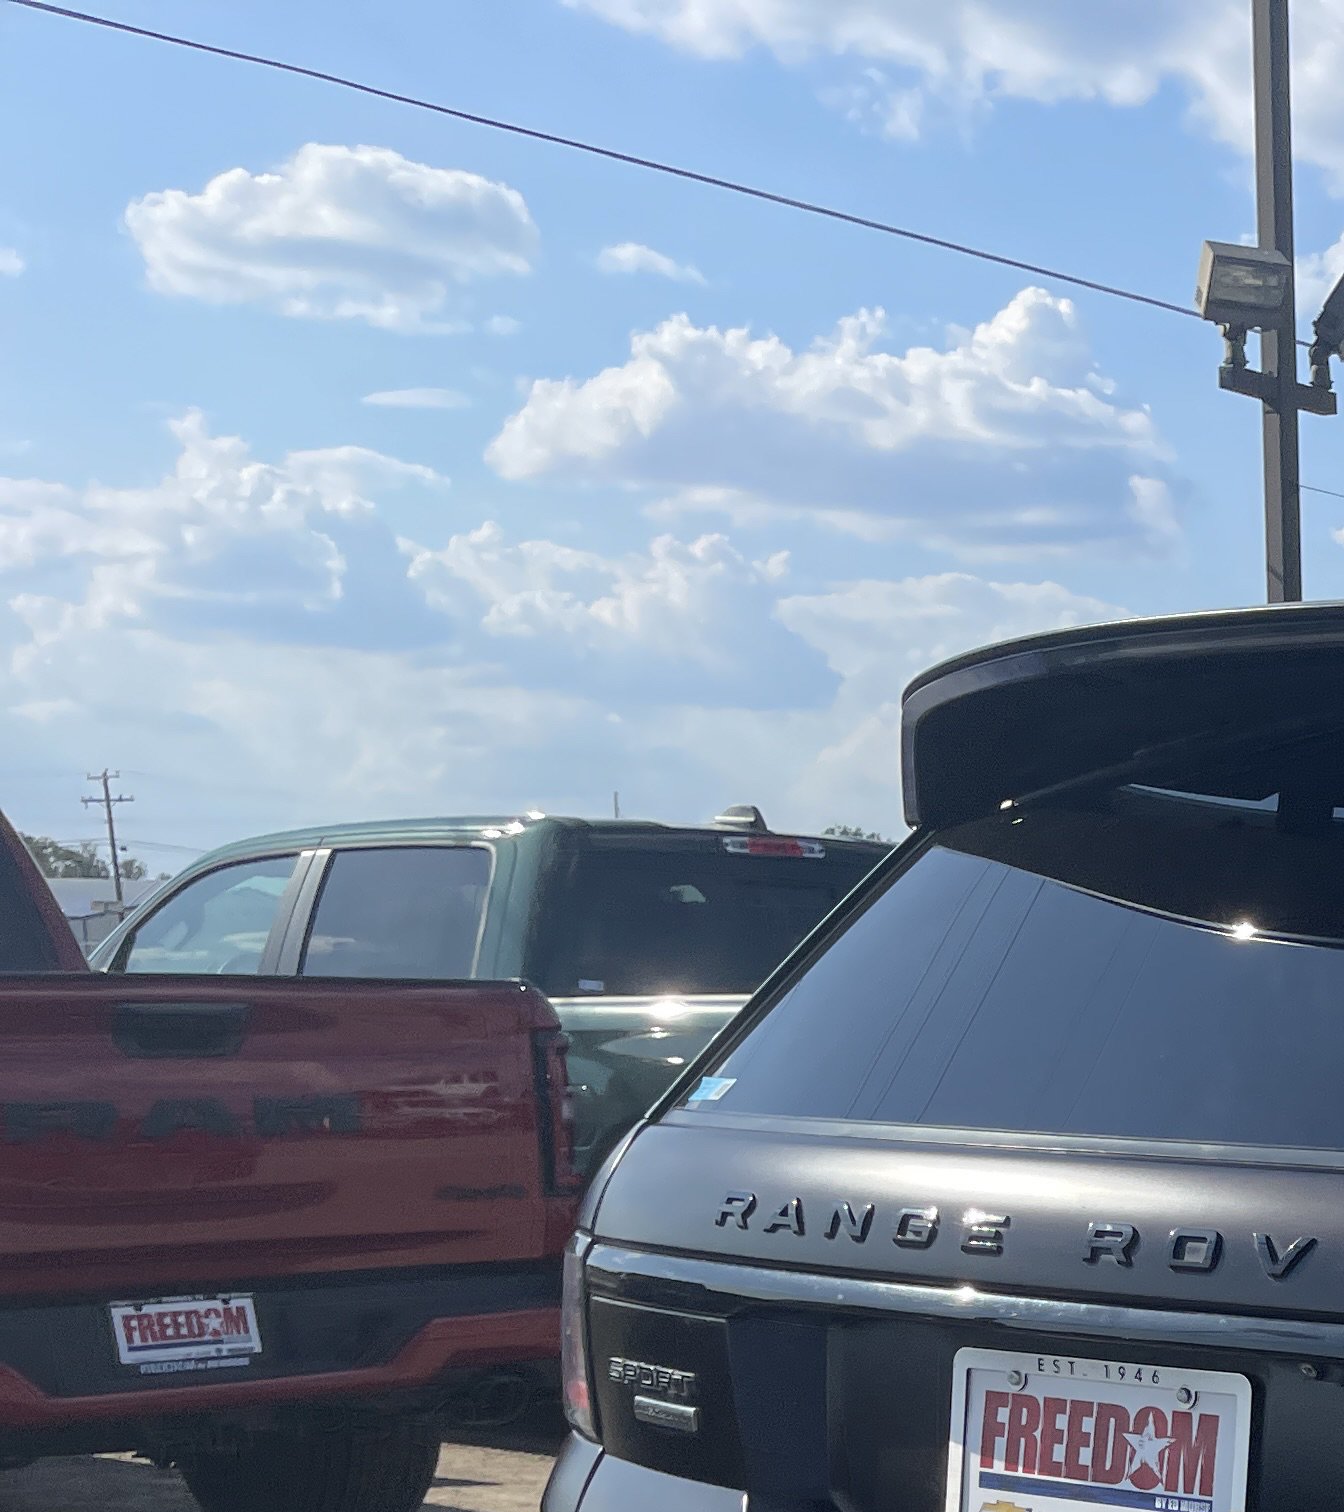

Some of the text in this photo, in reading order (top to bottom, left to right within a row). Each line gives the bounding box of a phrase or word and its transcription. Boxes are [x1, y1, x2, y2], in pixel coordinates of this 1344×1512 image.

[714, 1189, 1012, 1258] RANGE
[121, 1305, 250, 1345] FREEDOM
[608, 1356, 696, 1396] SPORT
[1037, 1357, 1160, 1385] EST. 1946
[979, 1389, 1220, 1497] FREEDOM
[1155, 1497, 1167, 1509] BY
